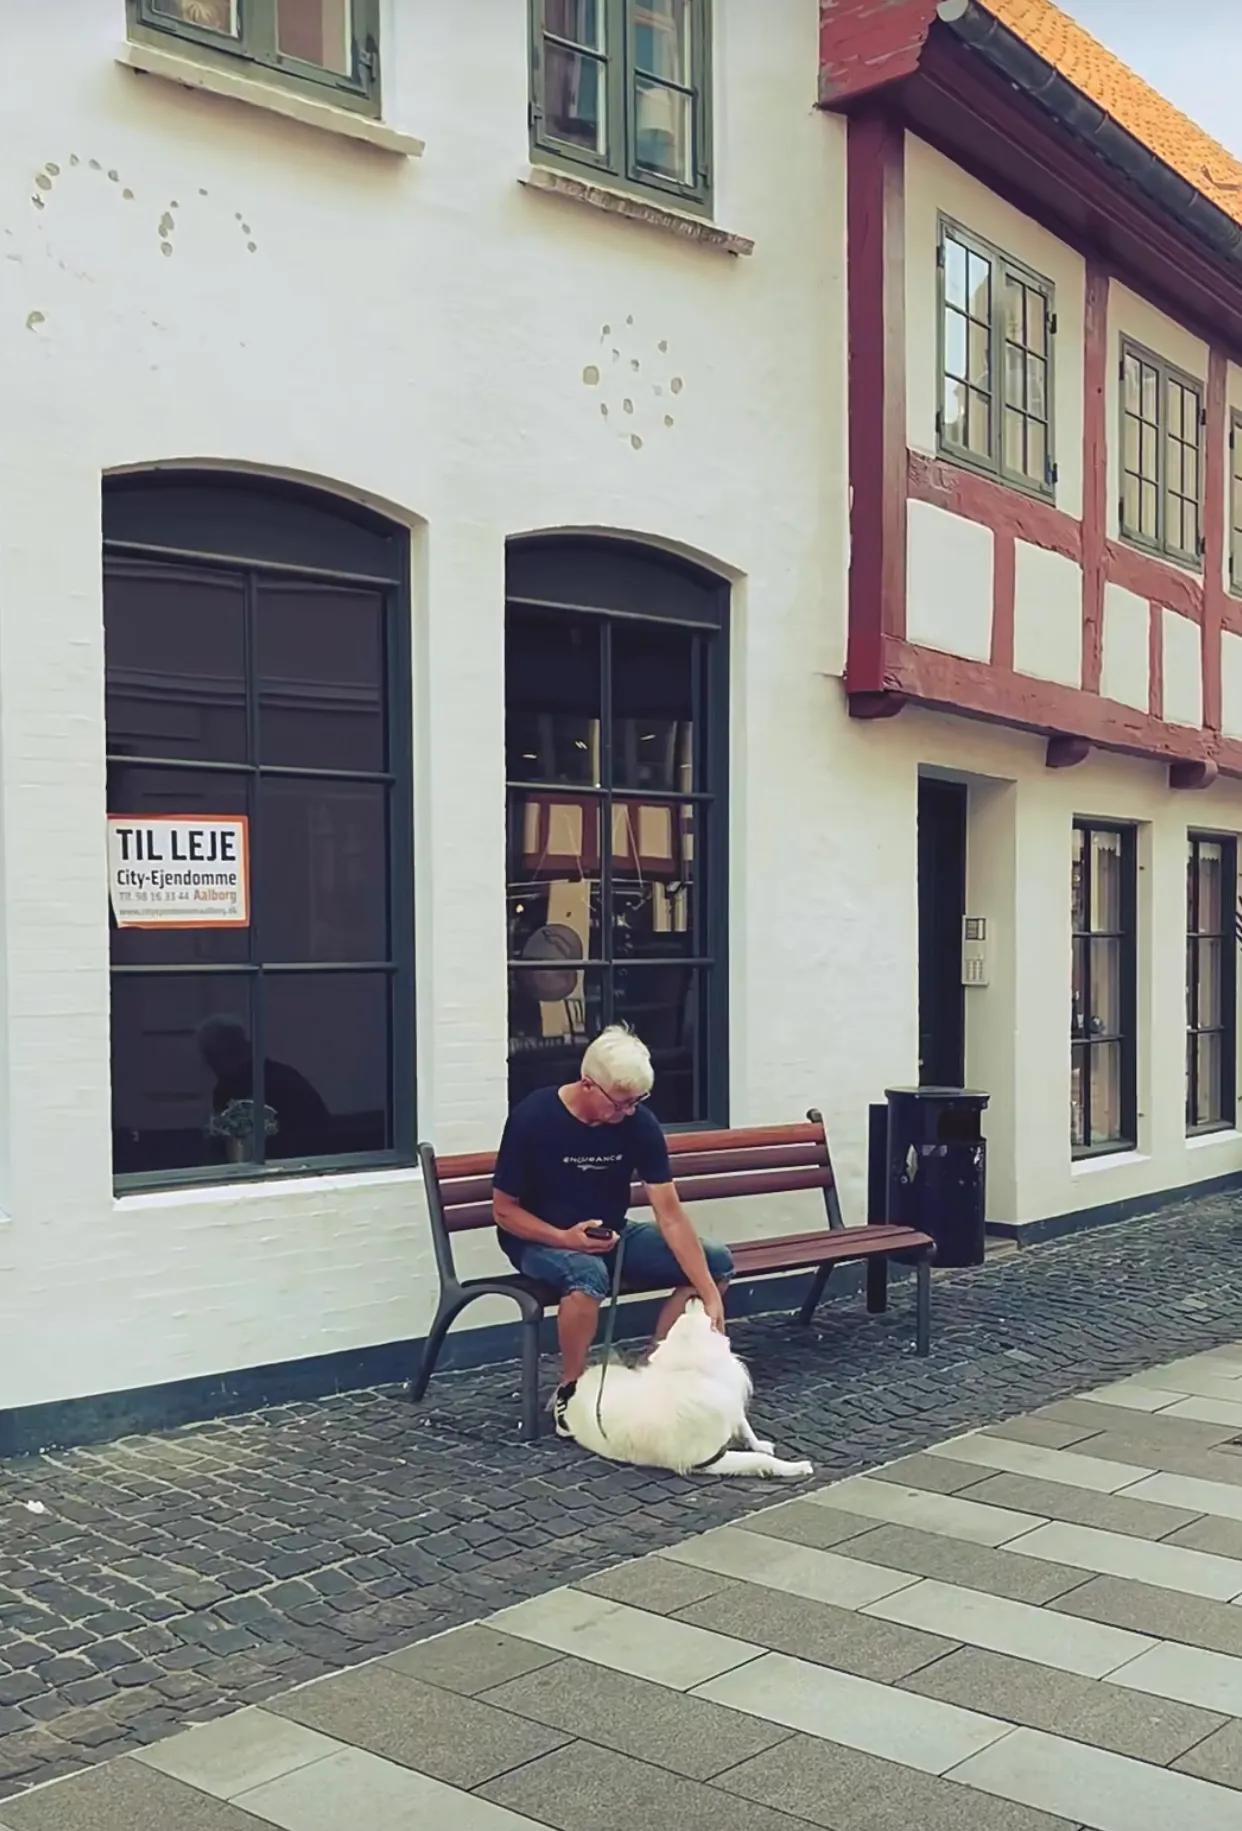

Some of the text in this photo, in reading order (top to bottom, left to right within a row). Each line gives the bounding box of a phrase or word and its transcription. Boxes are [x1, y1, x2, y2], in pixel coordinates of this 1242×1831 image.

[116, 829, 236, 861] TIL LEJE
[117, 869, 237, 889] City-Ejendomme
[178, 891, 189, 900] 44
[193, 889, 237, 904] Aalborg
